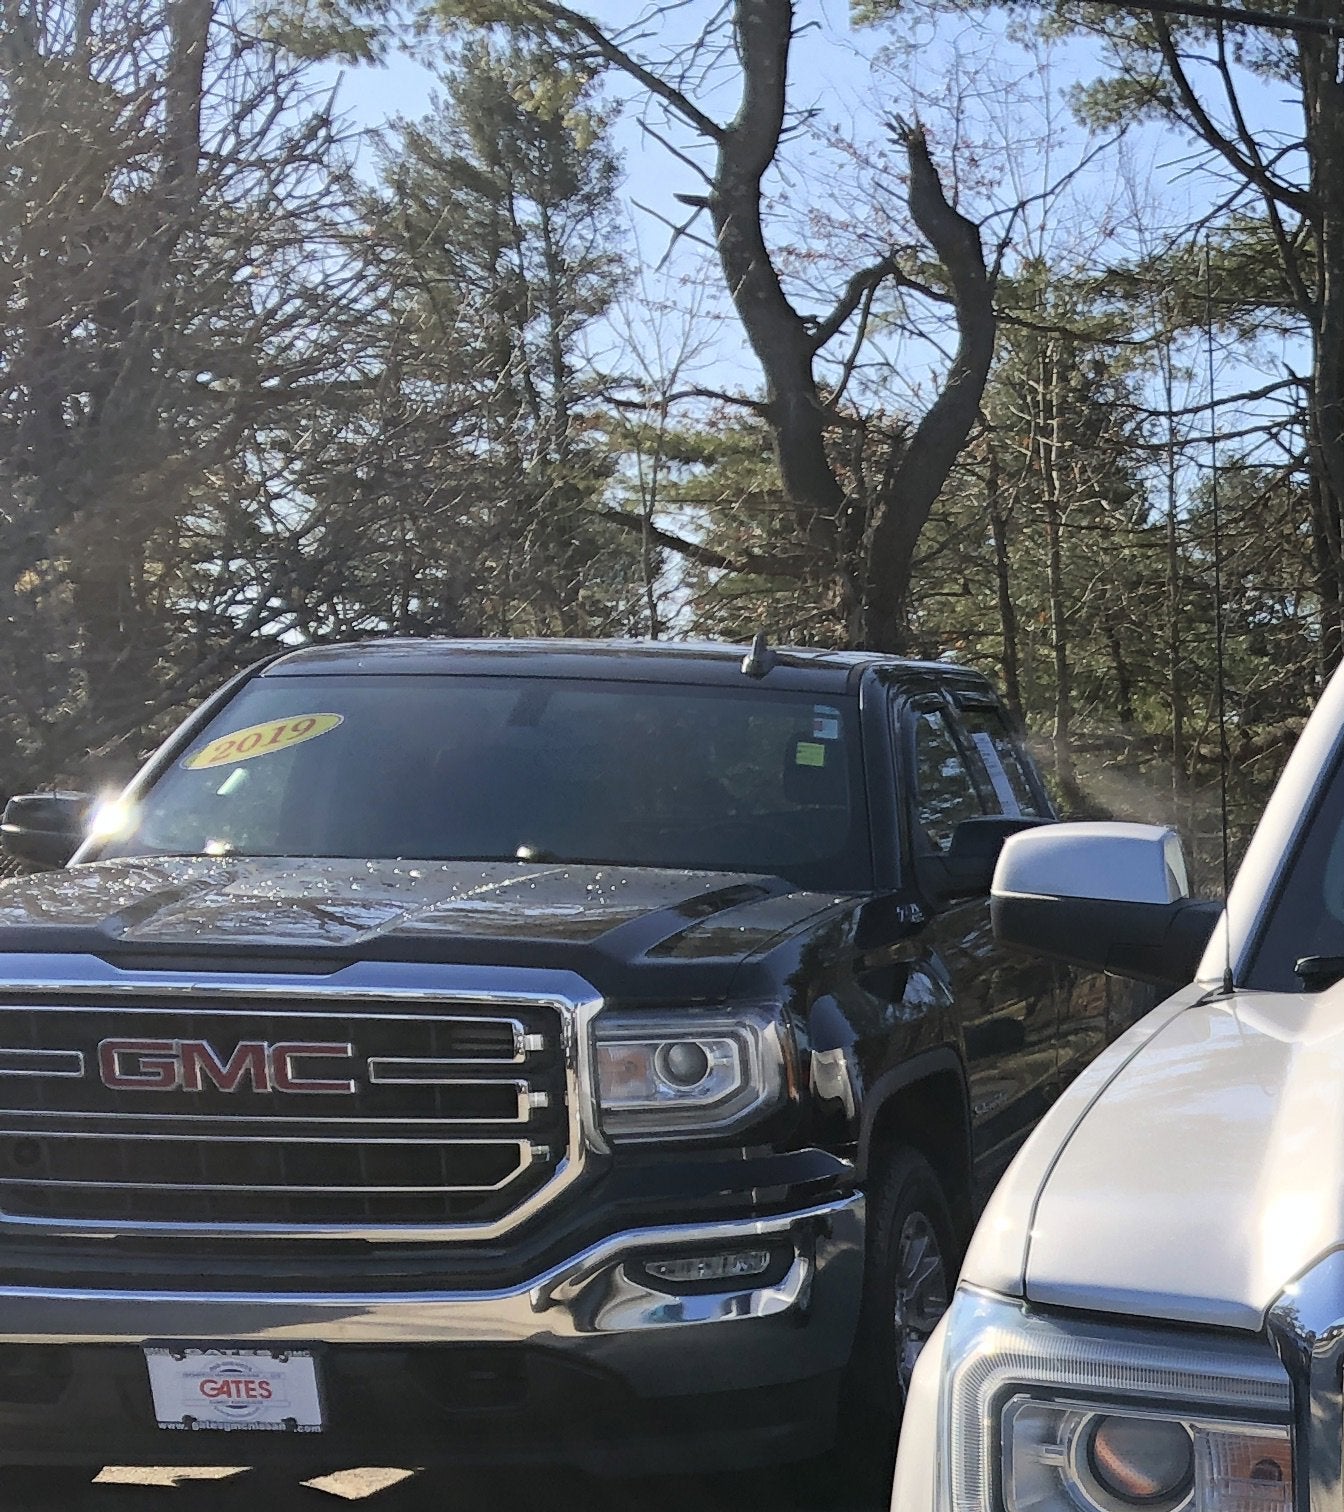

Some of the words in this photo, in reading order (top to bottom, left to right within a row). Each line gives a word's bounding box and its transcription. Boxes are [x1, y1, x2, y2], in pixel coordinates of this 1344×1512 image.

[208, 718, 317, 764] 2019
[97, 1037, 356, 1094] GMC
[199, 1378, 273, 1400] GATES
